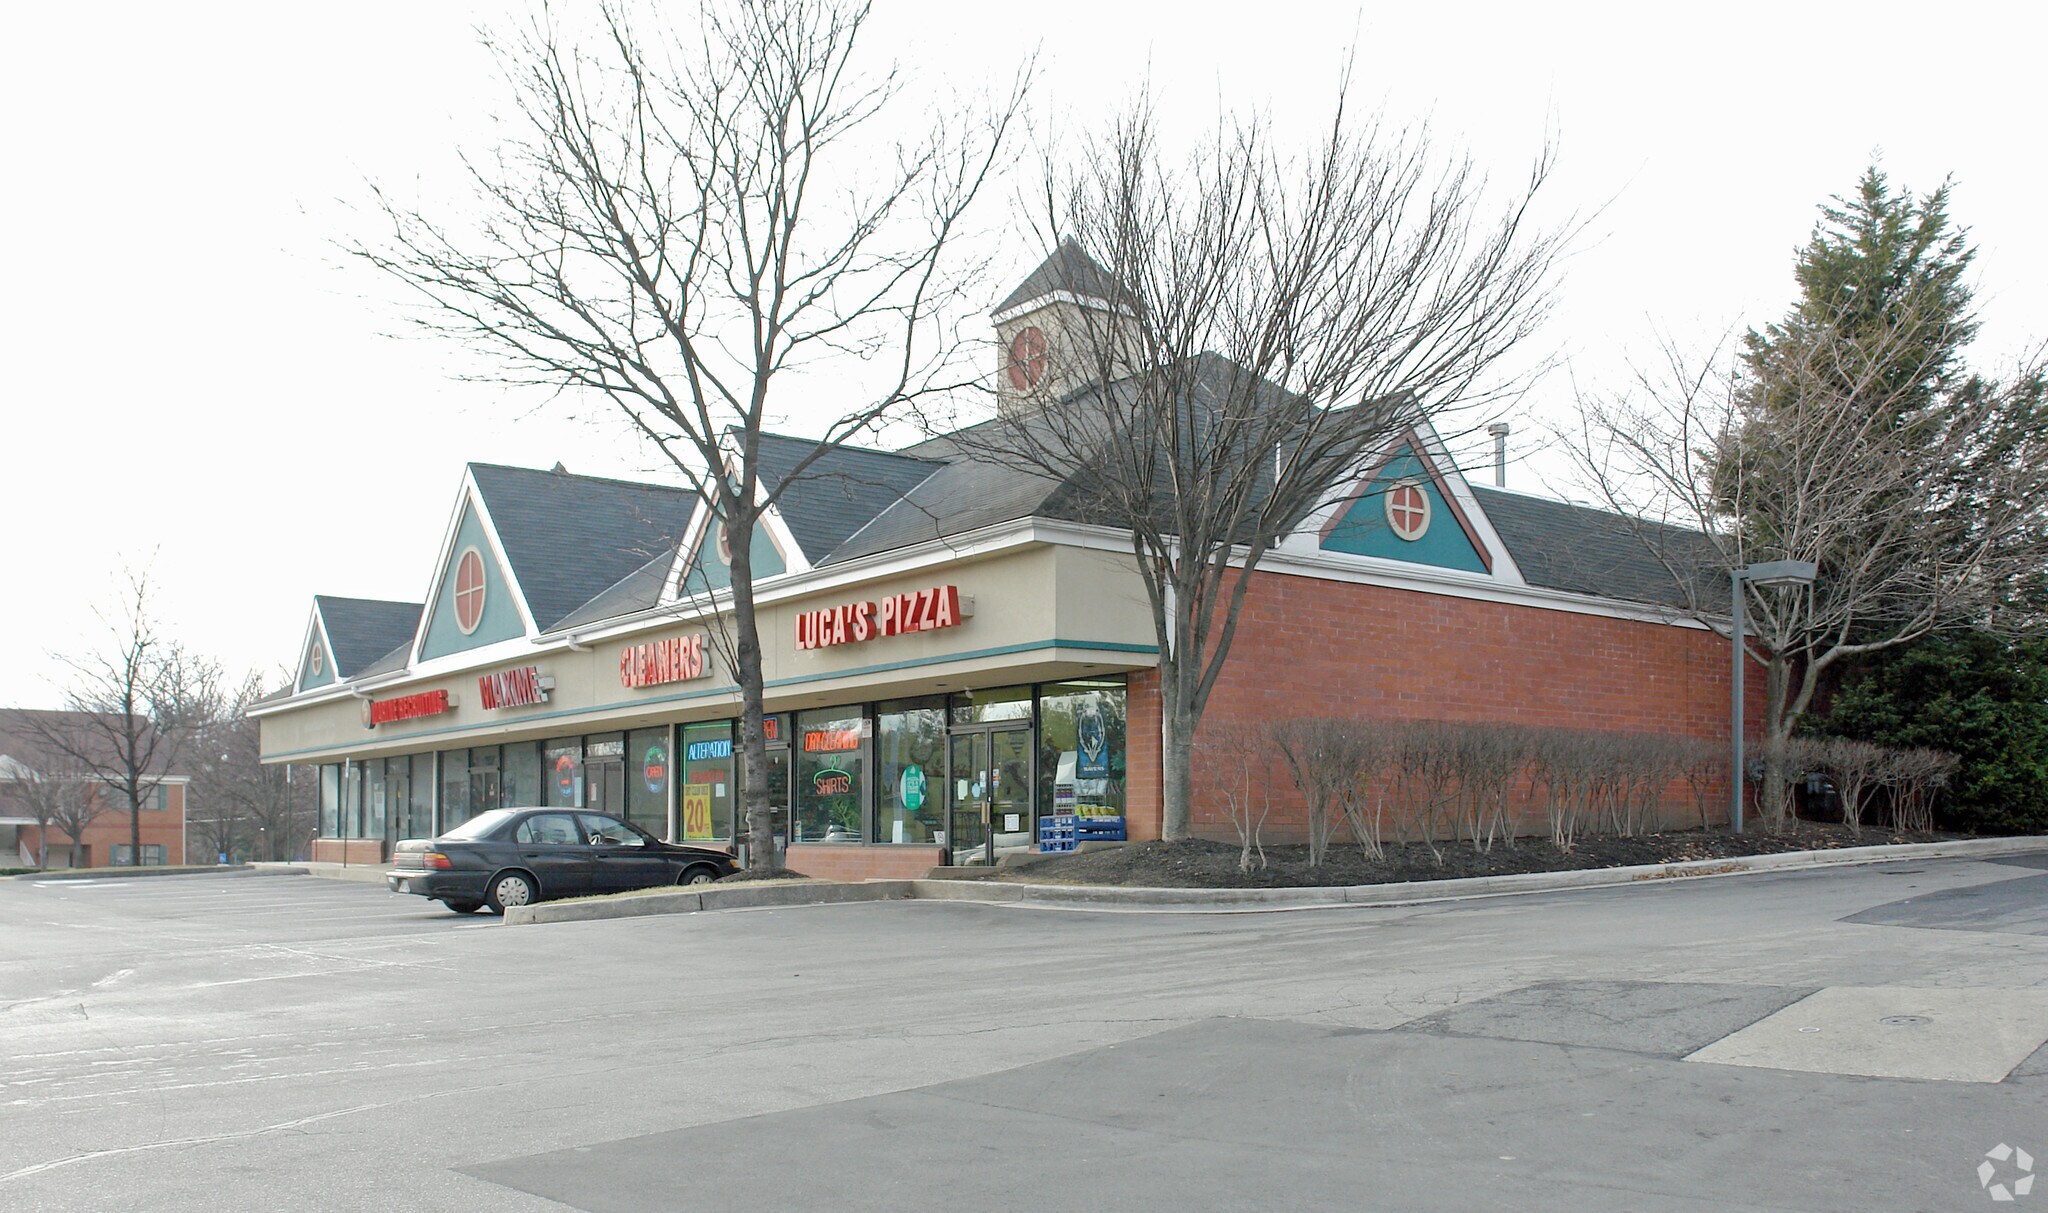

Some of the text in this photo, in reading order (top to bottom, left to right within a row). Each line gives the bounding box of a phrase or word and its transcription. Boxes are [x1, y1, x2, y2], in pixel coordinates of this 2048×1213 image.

[795, 585, 954, 651] LUCA'S PIZZA
[621, 633, 703, 688] CLEANERS
[479, 666, 544, 710] MAXIME
[816, 776, 849, 795] SHIRTS
